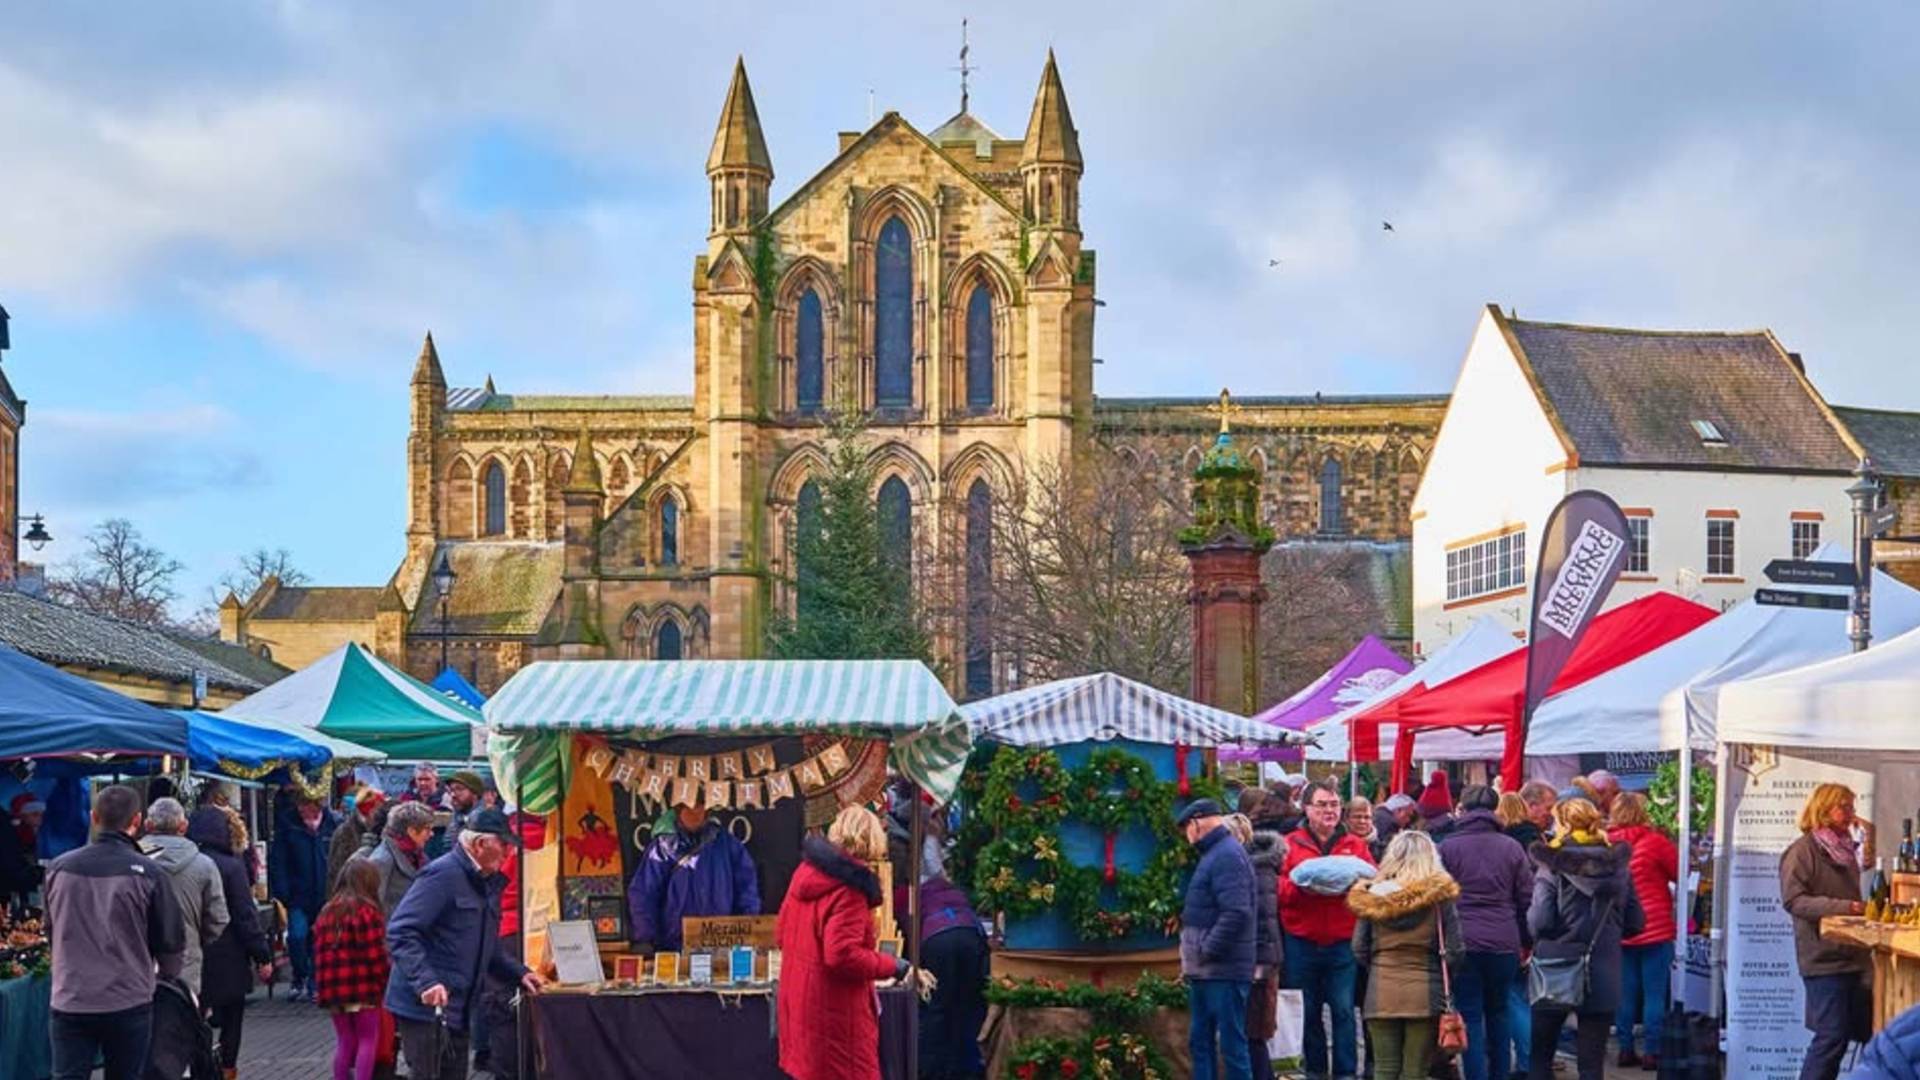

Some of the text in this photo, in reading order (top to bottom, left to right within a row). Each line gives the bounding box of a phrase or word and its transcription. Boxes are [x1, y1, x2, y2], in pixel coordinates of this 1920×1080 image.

[1545, 524, 1604, 622] MUCKLE
[1554, 530, 1614, 629] BREWING
[591, 750, 842, 803] CHRISTMAS
[1772, 780, 1820, 789] BEEKEEP
